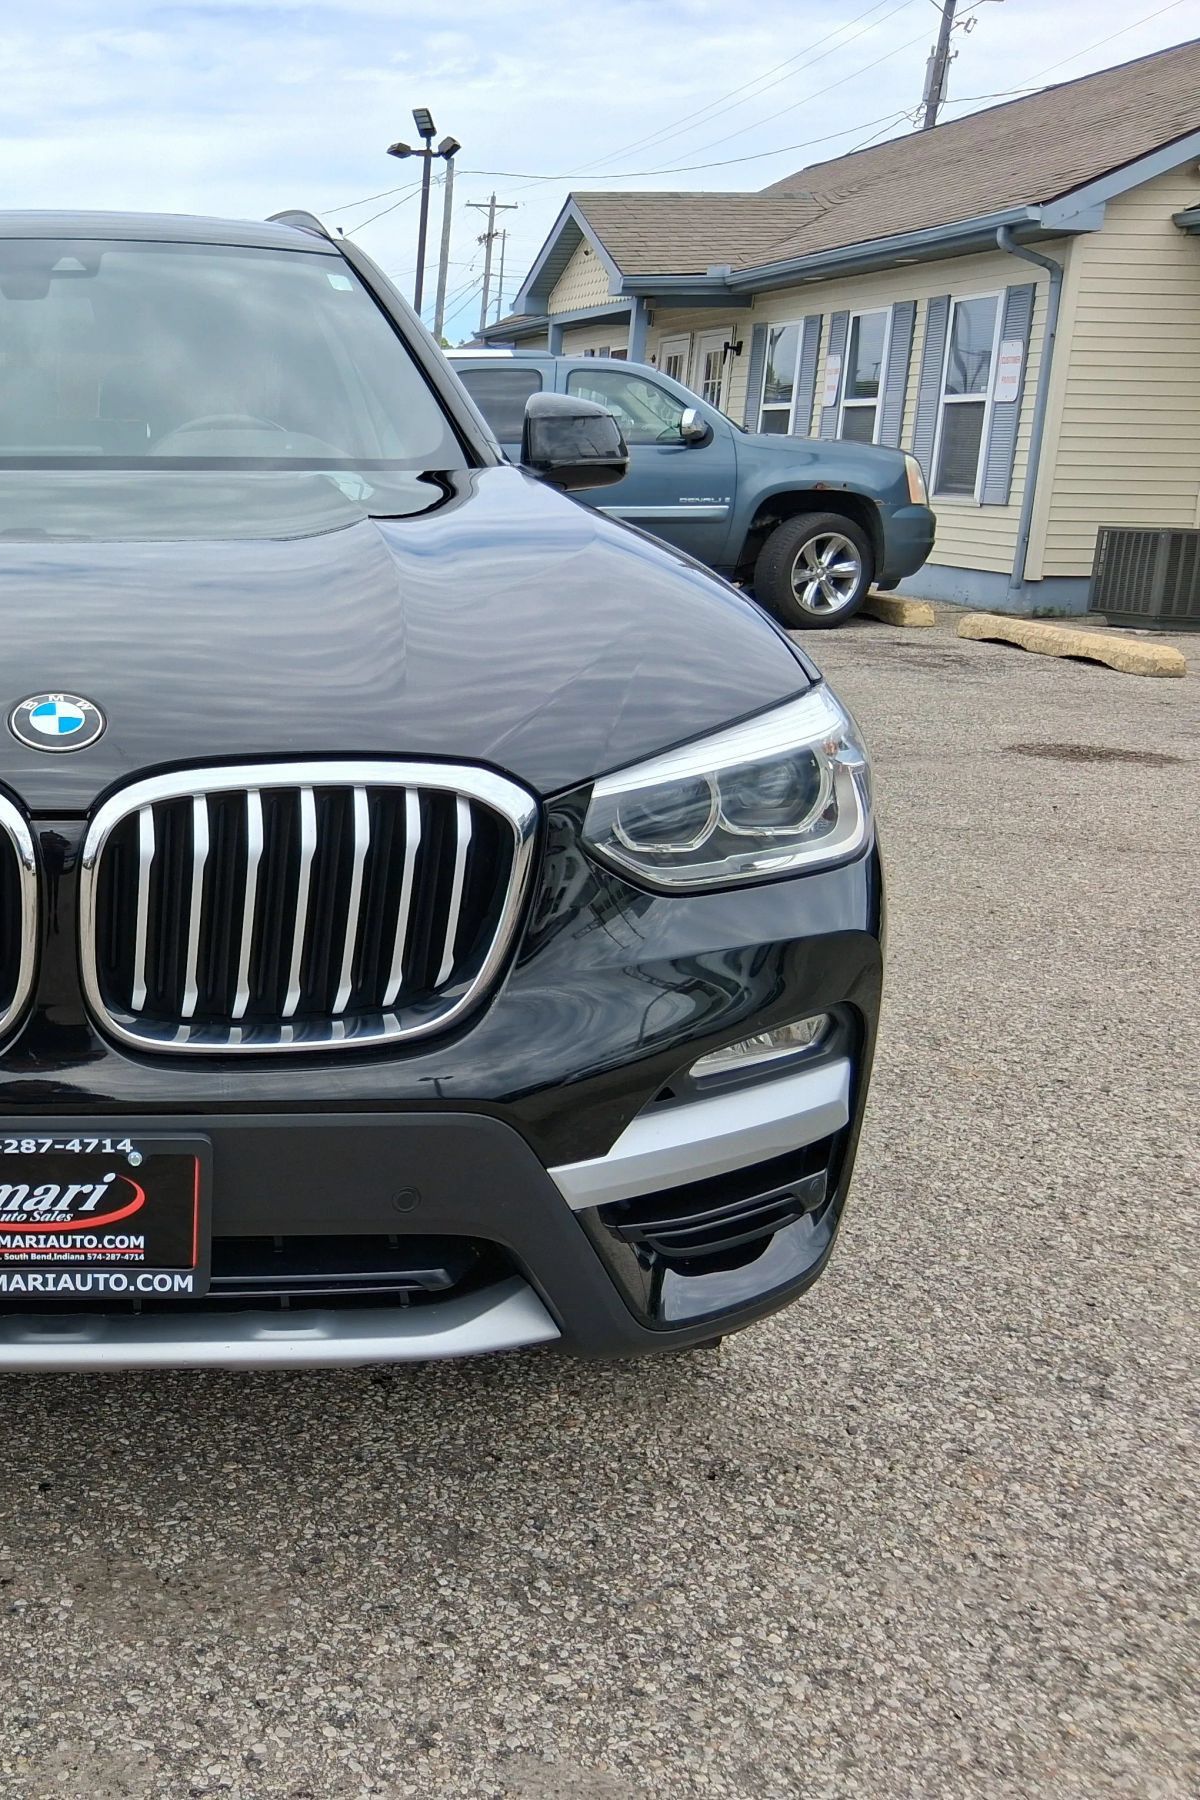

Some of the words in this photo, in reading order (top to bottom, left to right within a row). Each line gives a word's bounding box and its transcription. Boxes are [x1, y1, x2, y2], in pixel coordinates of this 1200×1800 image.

[21, 695, 94, 711] BMW
[29, 1210, 74, 1222] Sales
[4, 1253, 29, 1261] South
[86, 1253, 145, 1261] 574-287-4714
